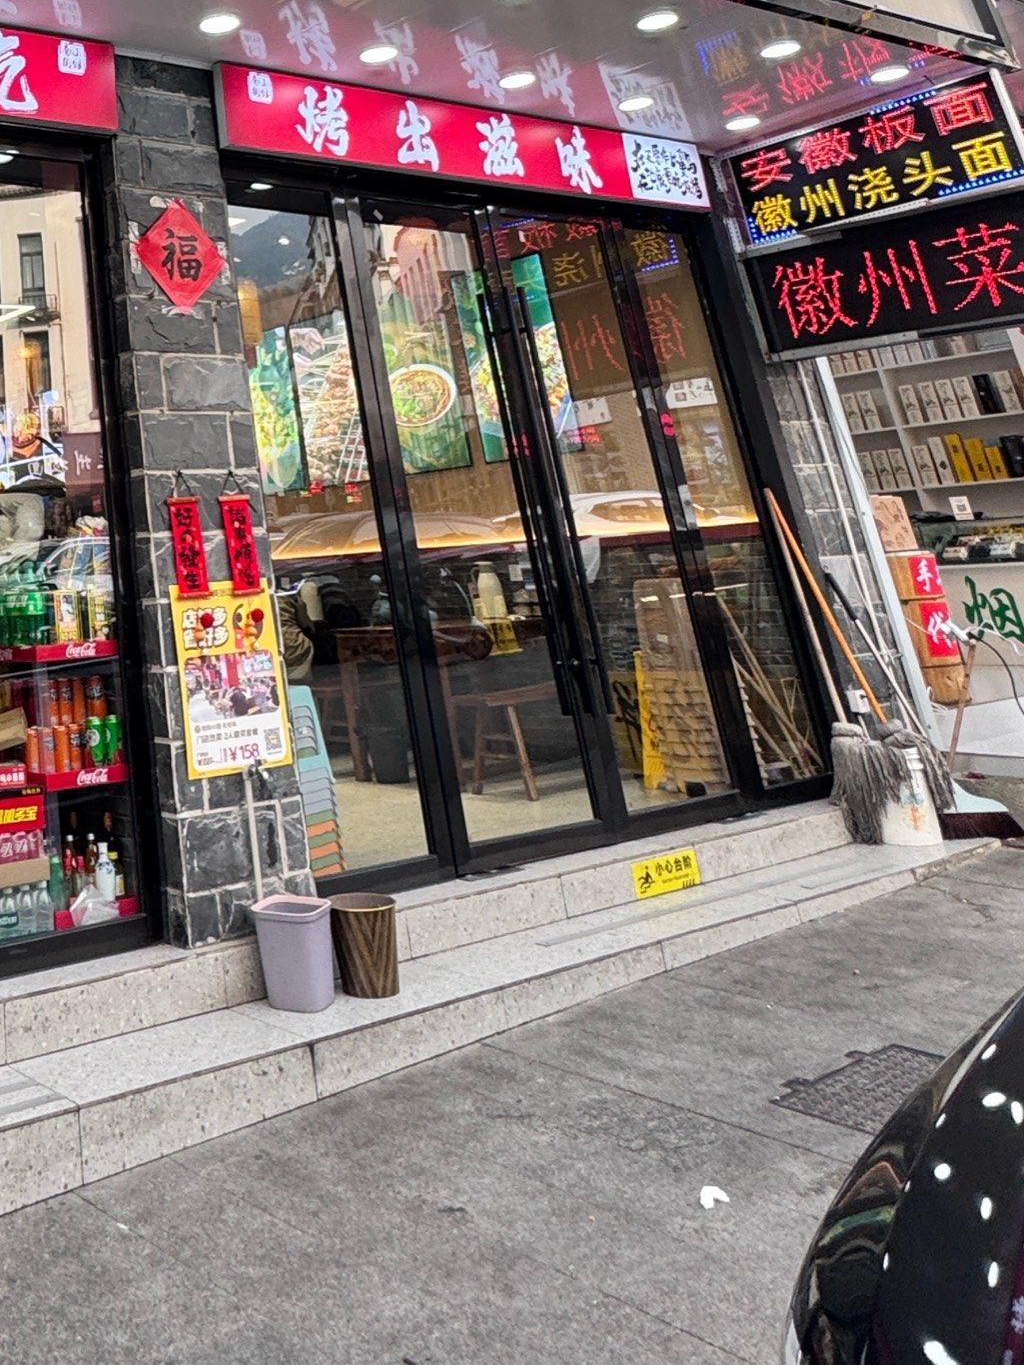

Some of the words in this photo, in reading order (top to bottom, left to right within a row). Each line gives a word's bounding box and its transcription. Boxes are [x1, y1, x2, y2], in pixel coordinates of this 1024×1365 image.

[295, 83, 604, 195] 烤出滋味
[740, 82, 995, 192] 安徽板面
[751, 131, 1014, 235] 徽州浇头面
[161, 227, 203, 282] 福
[772, 222, 1024, 339] 徽州菜
[962, 575, 1024, 644] 烟
[655, 855, 693, 877] 小心台阶
